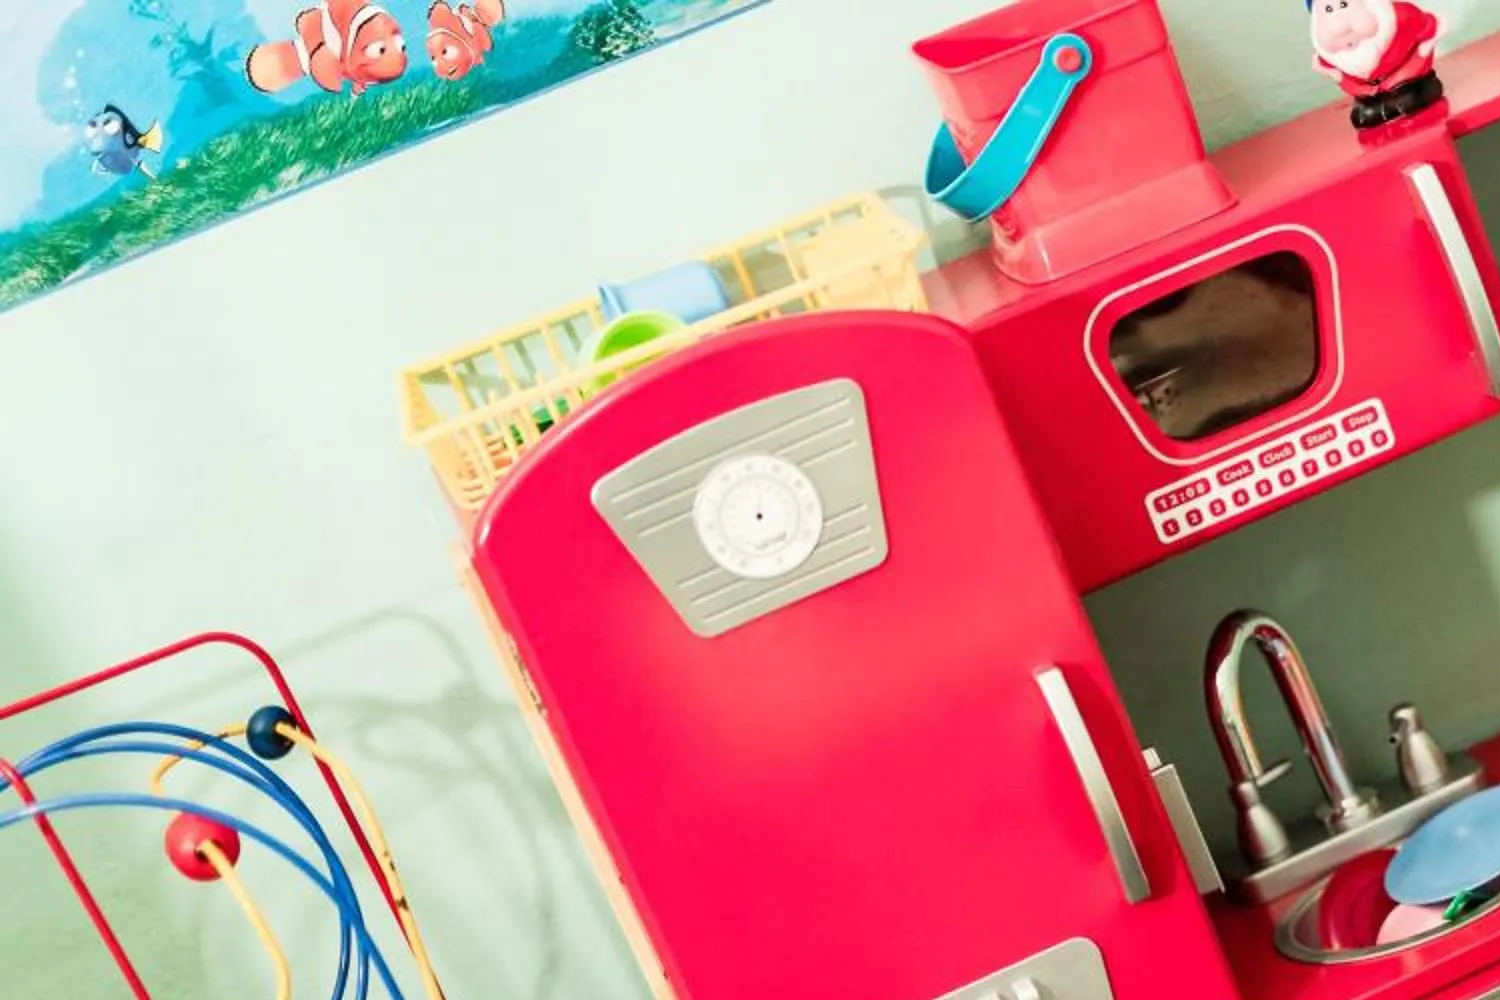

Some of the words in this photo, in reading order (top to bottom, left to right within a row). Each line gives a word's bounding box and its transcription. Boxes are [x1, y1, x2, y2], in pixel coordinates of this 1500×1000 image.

[1262, 444, 1294, 467] Clock
[1166, 522, 1176, 535] 1
[1190, 512, 1200, 525] 2
[1213, 501, 1222, 515] 3
[1304, 462, 1315, 475] 7
